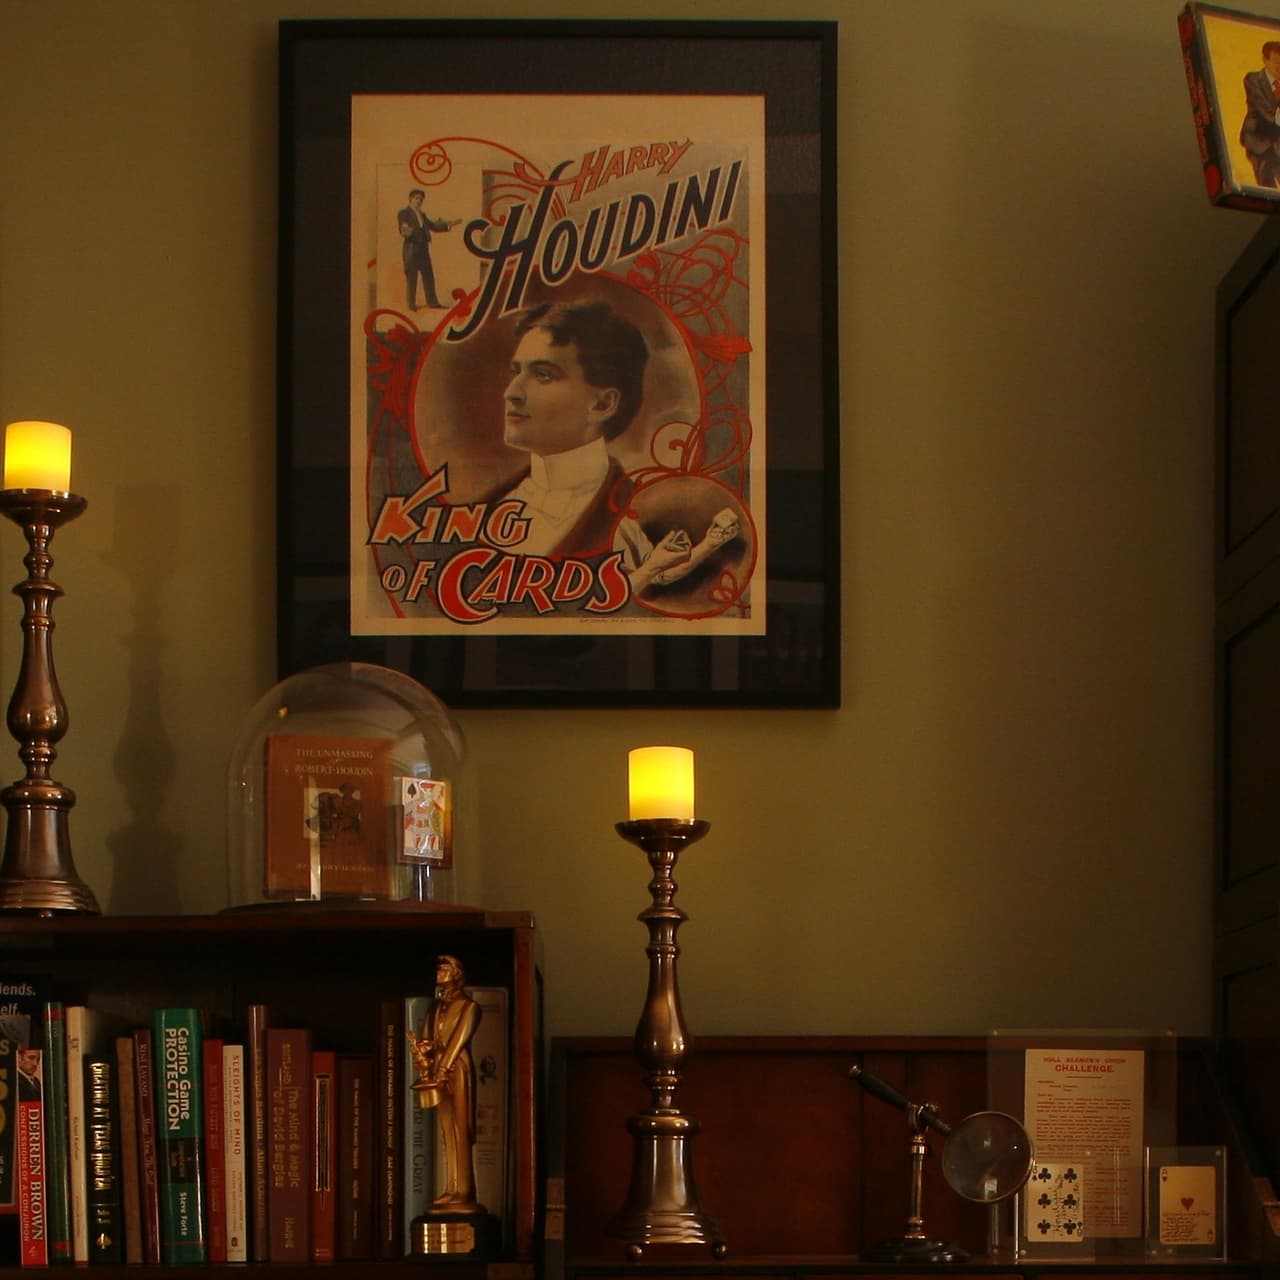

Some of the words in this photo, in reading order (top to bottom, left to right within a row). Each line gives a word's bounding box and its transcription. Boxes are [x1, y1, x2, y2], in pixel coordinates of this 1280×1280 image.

[572, 138, 693, 202] HARRY
[447, 159, 742, 341] HOUDINI
[367, 463, 533, 547] KING
[382, 562, 438, 601] OF
[439, 550, 634, 625] CARDS
[165, 1028, 180, 1130] PROTECTION
[177, 1027, 189, 1076] Casino
[90, 1063, 110, 1103] CHEATING
[92, 1107, 107, 1118] AT
[179, 1080, 191, 1120] Game
[28, 1108, 40, 1175] DERREN
[90, 1122, 111, 1149] TEXAS
[30, 1181, 42, 1240] BROWN
